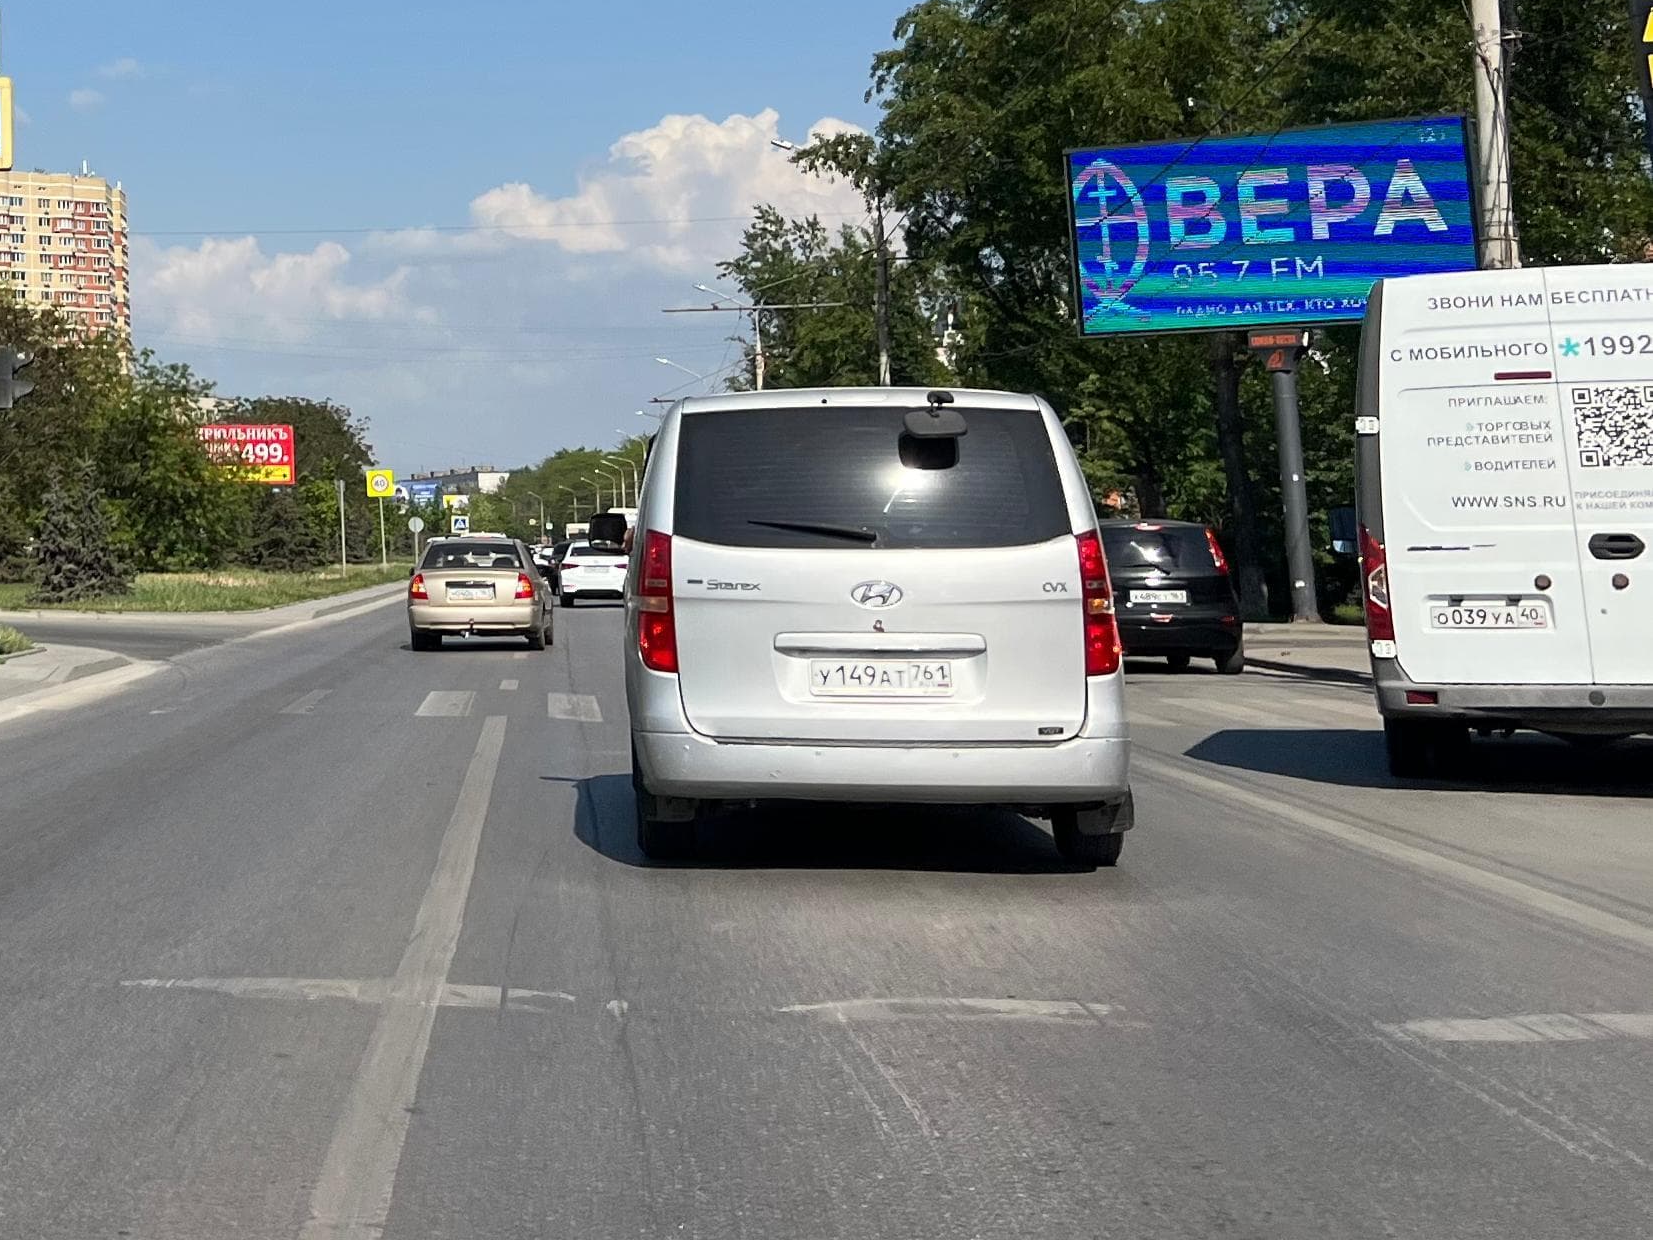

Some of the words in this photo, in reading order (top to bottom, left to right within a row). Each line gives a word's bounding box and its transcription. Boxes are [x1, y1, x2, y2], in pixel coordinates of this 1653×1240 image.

[1165, 158, 1448, 250] ВЕРА
[1428, 296, 1494, 310] ЗВОНИ
[1501, 293, 1543, 307] НАМ
[1391, 350, 1402, 362] С
[1409, 343, 1548, 361] МОБИЛЬНОГО
[1478, 421, 1551, 432] ТОРГОВЫХ
[195, 427, 288, 441] РЮЛЬНИКЪ
[1428, 434, 1553, 447] ПРЕДСТАВИТЕЛЕЙ
[1475, 459, 1557, 471] ВОДИТЕЛЕЙ
[374, 479, 386, 488] 40
[1452, 495, 1567, 508] WWW.SNS.RU
[707, 579, 762, 591] Starex
[1042, 582, 1068, 593] CVX
[1521, 607, 1539, 621] 40
[911, 664, 948, 681] 761
